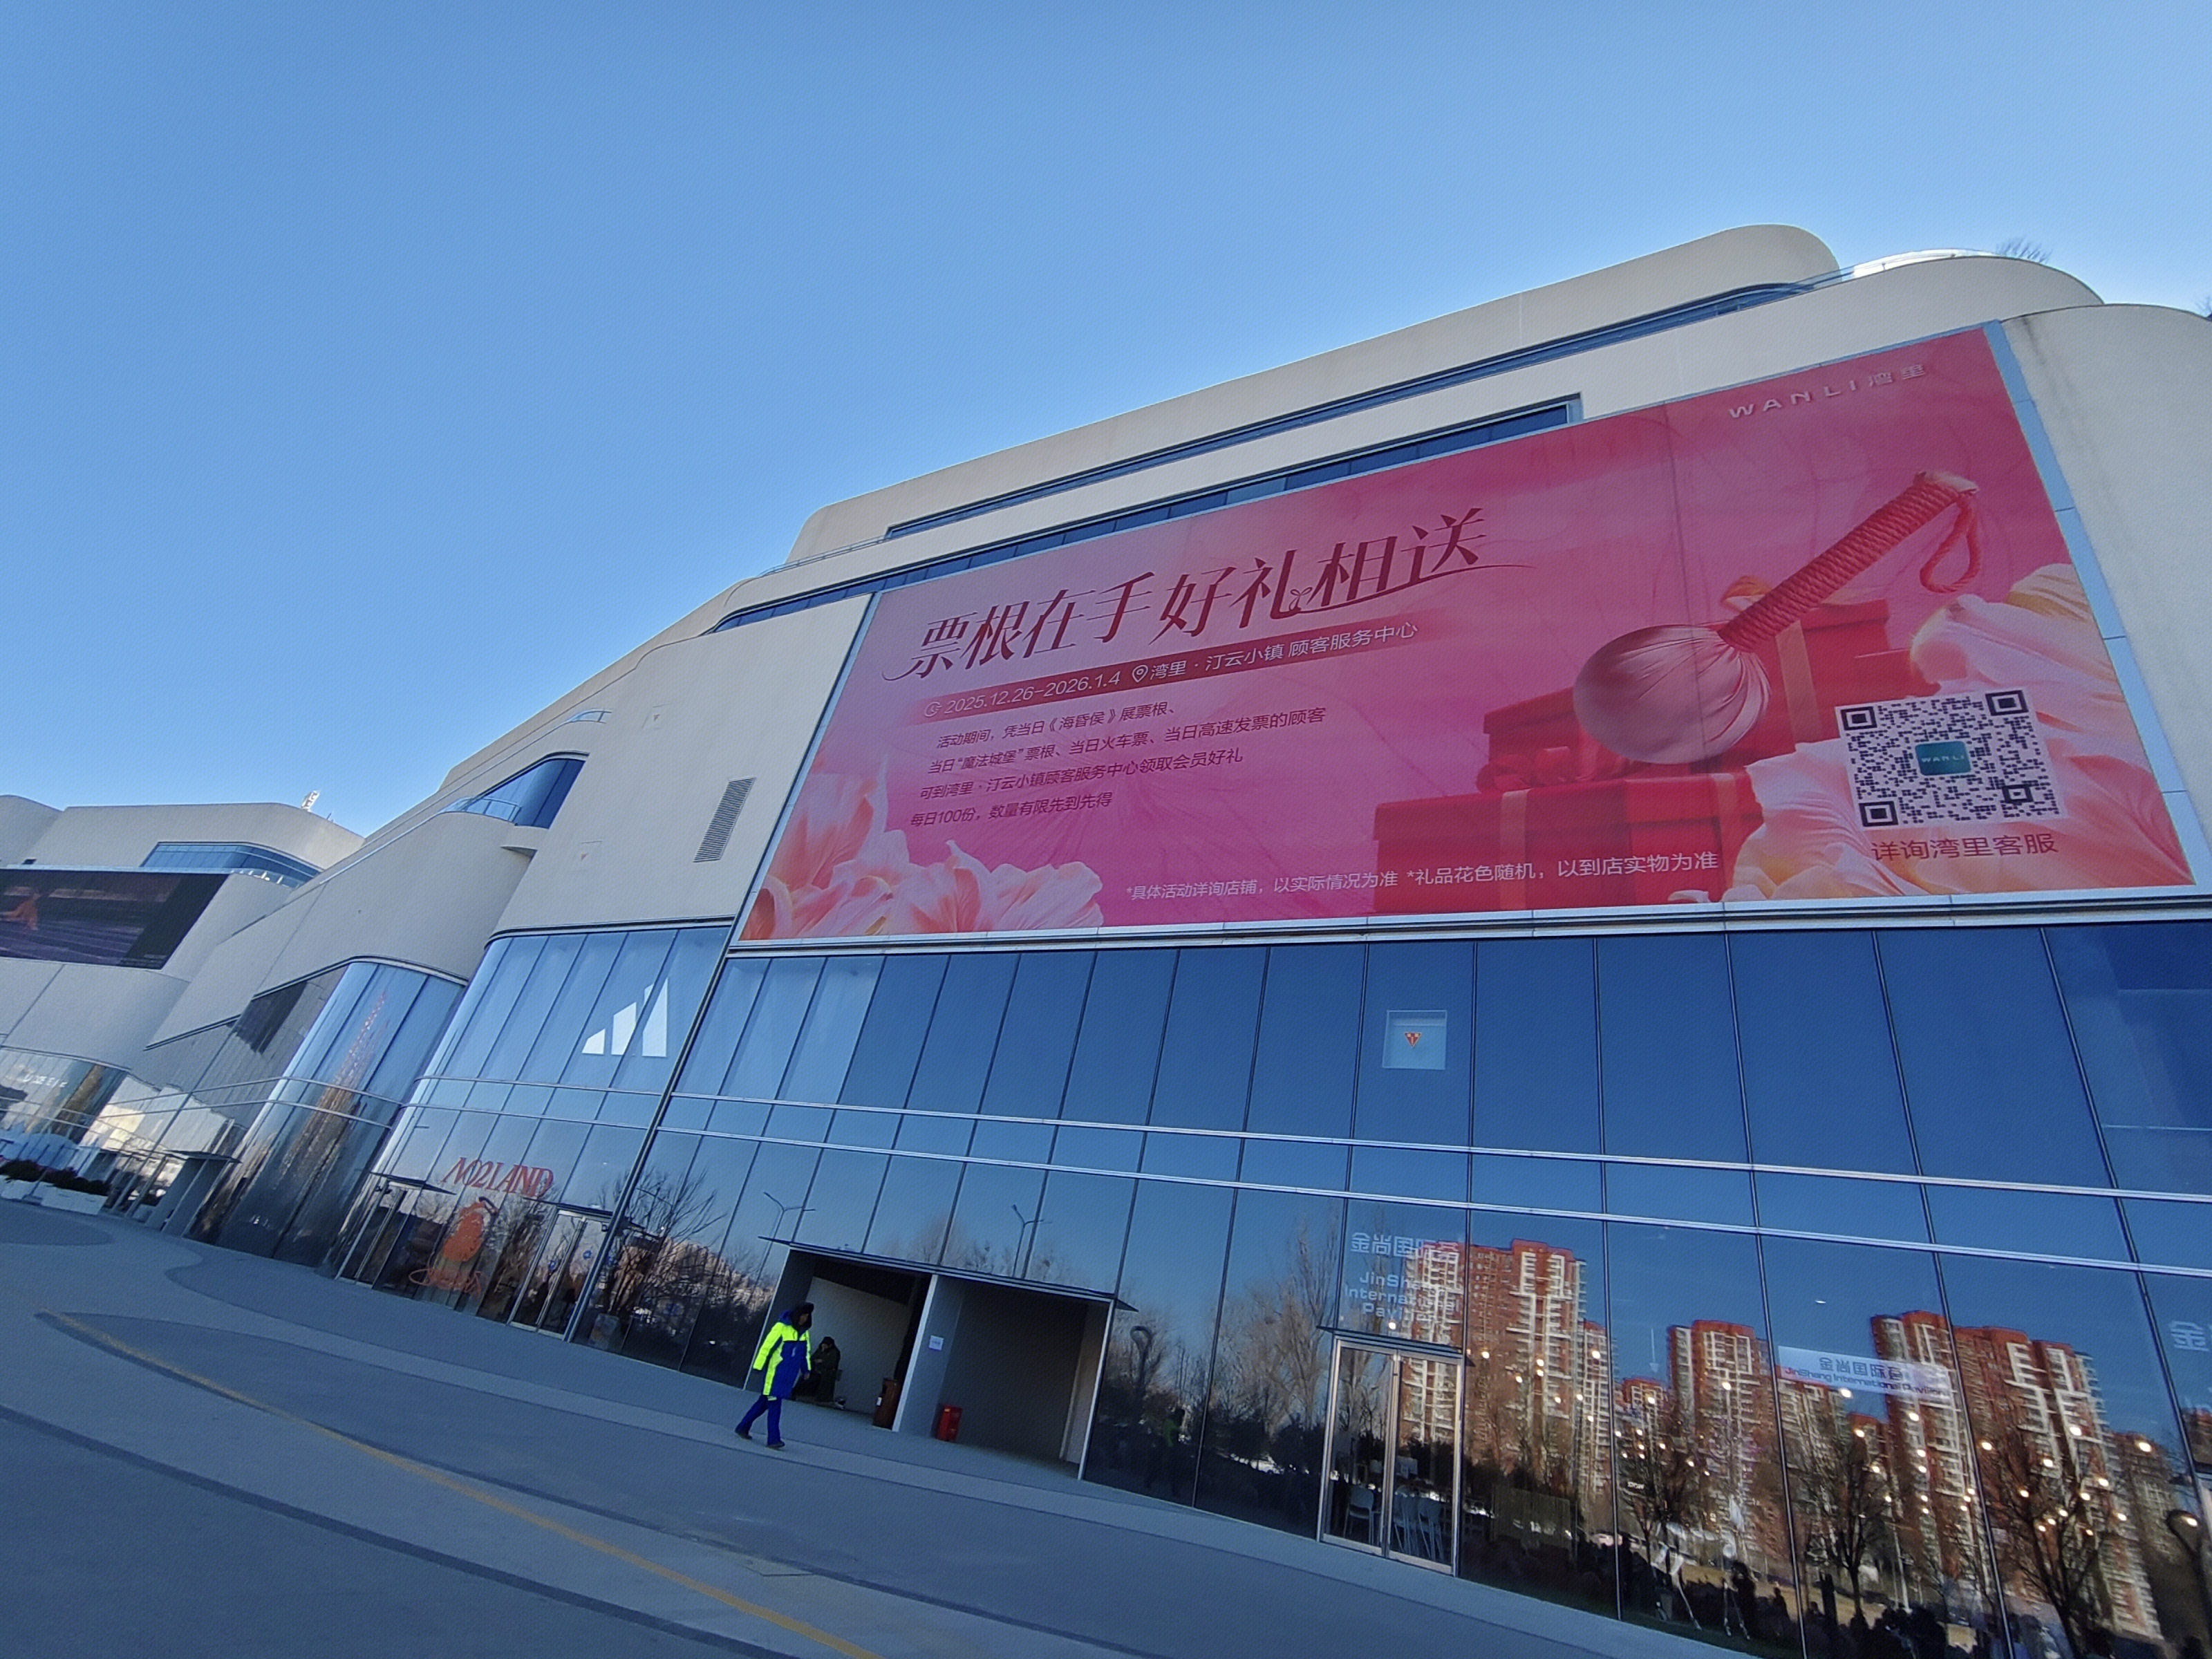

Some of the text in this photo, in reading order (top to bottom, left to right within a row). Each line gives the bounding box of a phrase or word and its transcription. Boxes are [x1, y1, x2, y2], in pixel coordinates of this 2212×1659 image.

[1729, 379, 1857, 419] WANLI
[883, 507, 1488, 679] 票根在手好礼相送
[943, 671, 1121, 715] 2025.12.26-2026.1.4
[1287, 621, 1418, 658] 顾客服务中心
[910, 791, 1113, 828] 每日100份，数量有限先到先得
[1871, 833, 2059, 861] 详询湾里客服
[2168, 1320, 2212, 1352] 金
